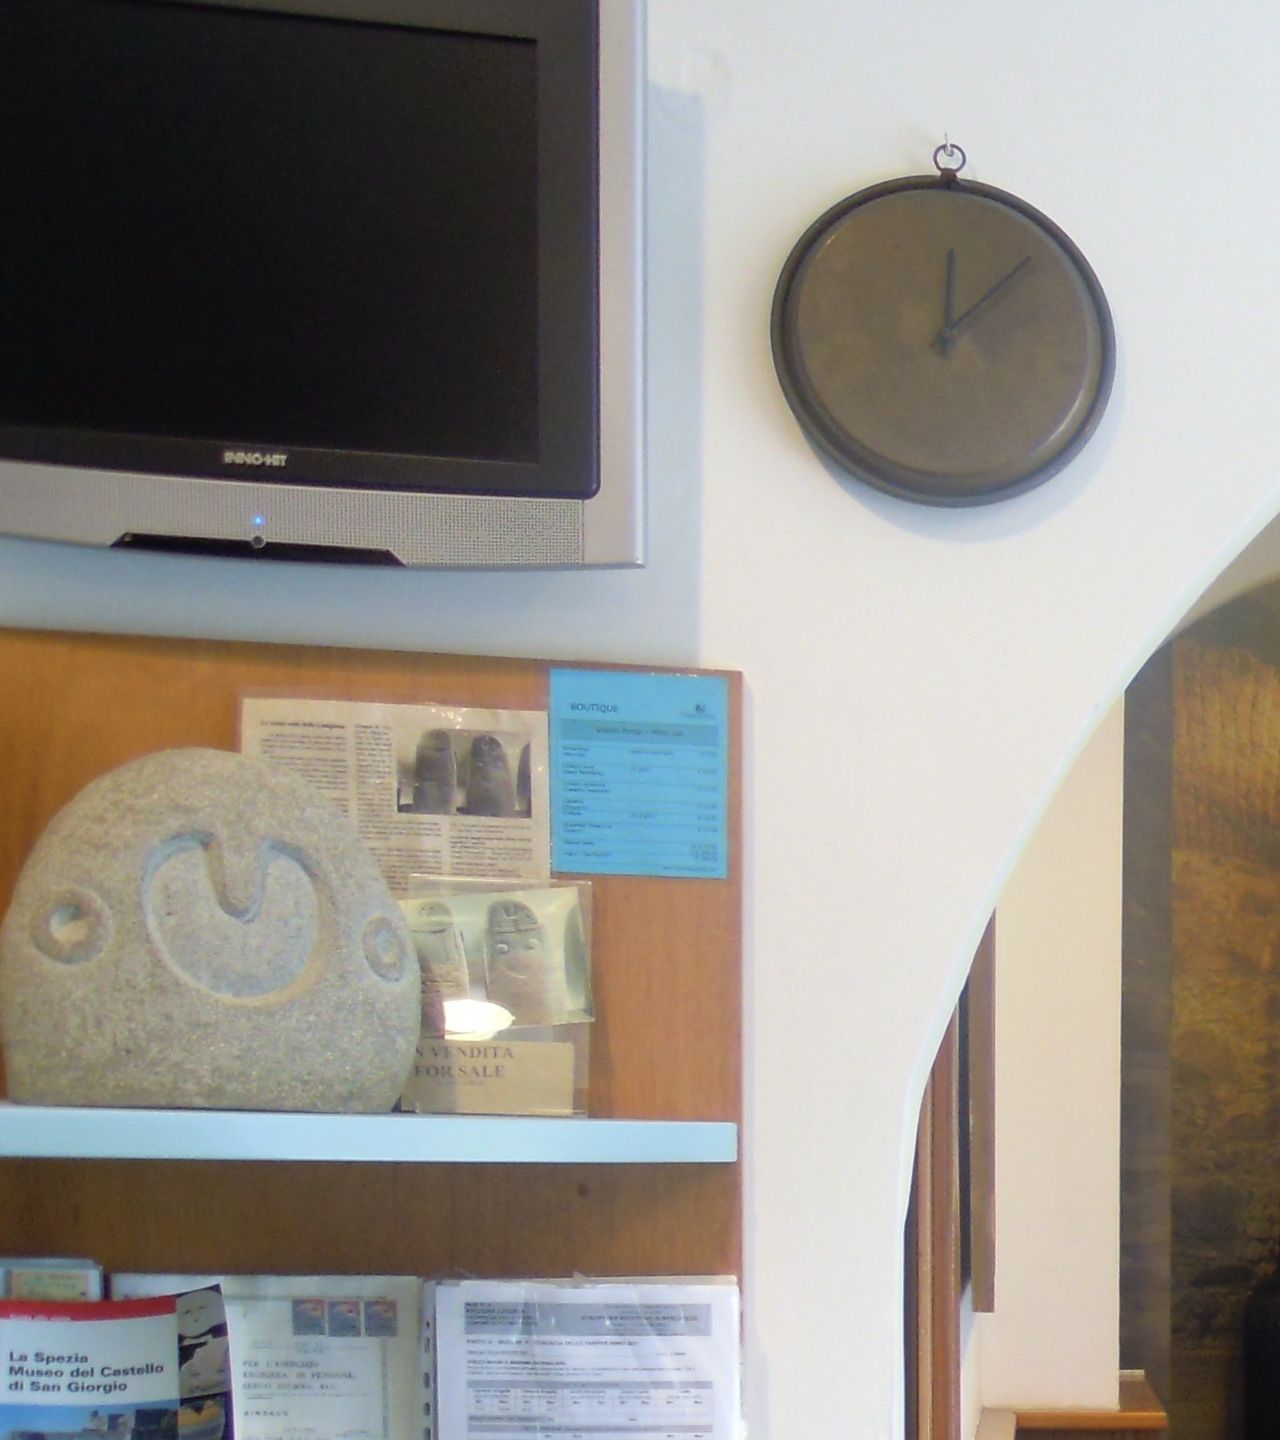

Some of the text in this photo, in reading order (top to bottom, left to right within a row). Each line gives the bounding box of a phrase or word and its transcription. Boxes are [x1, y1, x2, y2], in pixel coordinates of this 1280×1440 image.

[570, 703, 618, 713] BOUTIQUE
[431, 1046, 513, 1059] VENDITA
[415, 1064, 505, 1079] FOR SALE
[9, 1352, 89, 1365] La Spezia
[9, 1364, 164, 1378] Museo del Castello
[8, 1381, 128, 1394] di San Giorgio
